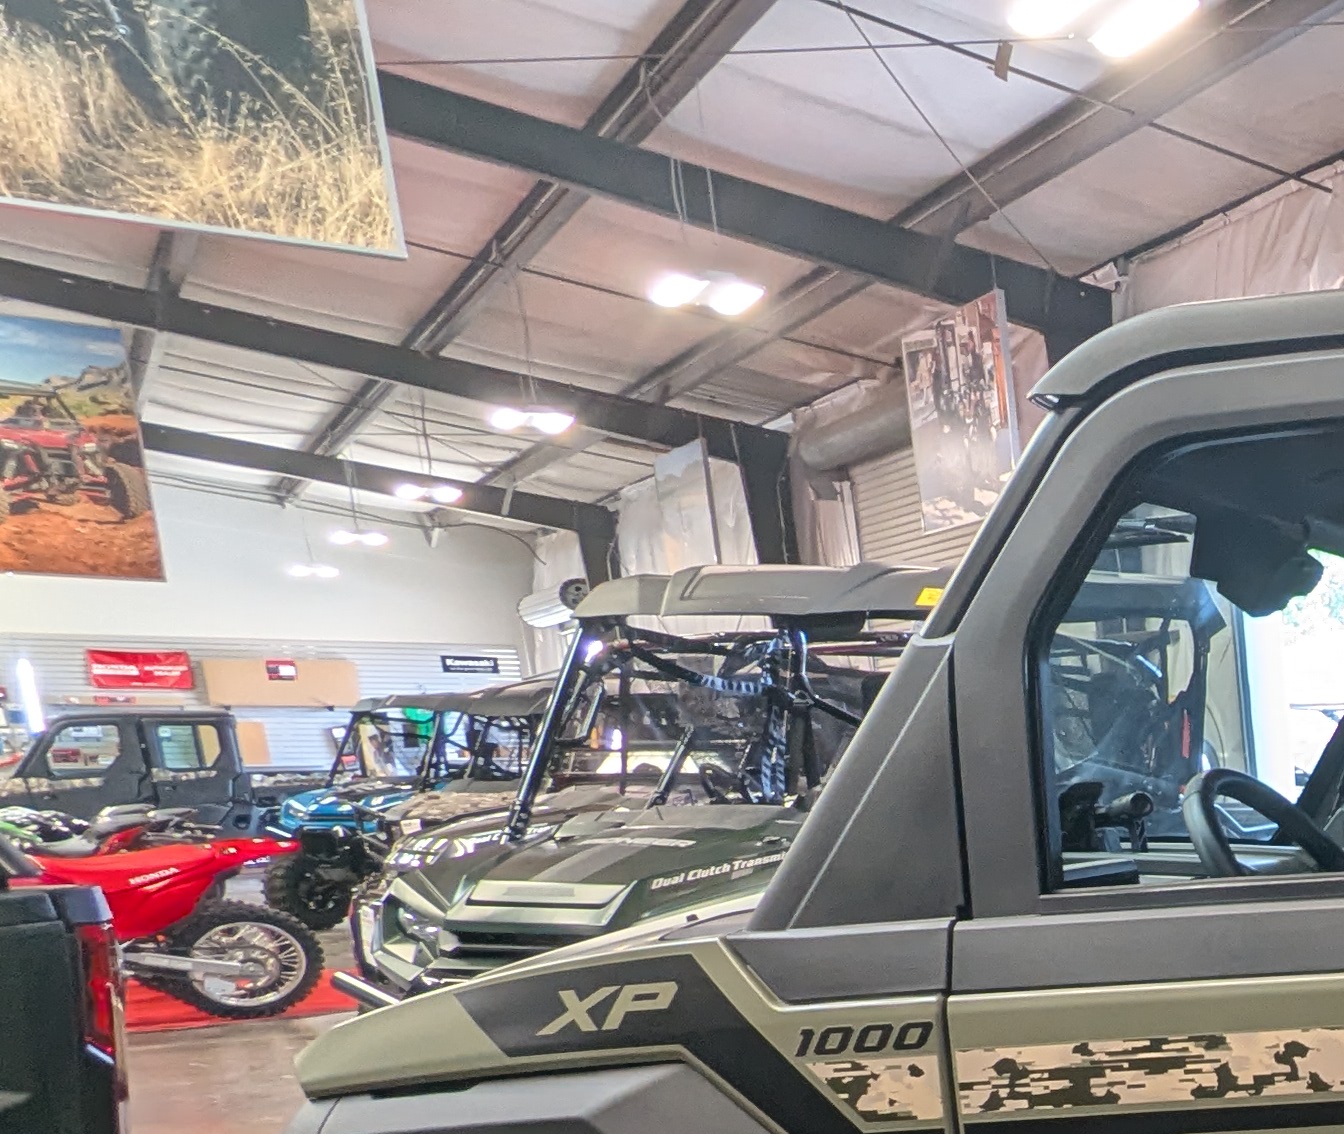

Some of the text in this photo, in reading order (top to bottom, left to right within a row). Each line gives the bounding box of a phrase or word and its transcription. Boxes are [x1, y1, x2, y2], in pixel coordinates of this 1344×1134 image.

[129, 867, 180, 885] HONDA
[651, 872, 686, 890] Dual
[686, 862, 731, 881] Clutch
[535, 980, 679, 1037] XP
[795, 1020, 934, 1058] 1000
